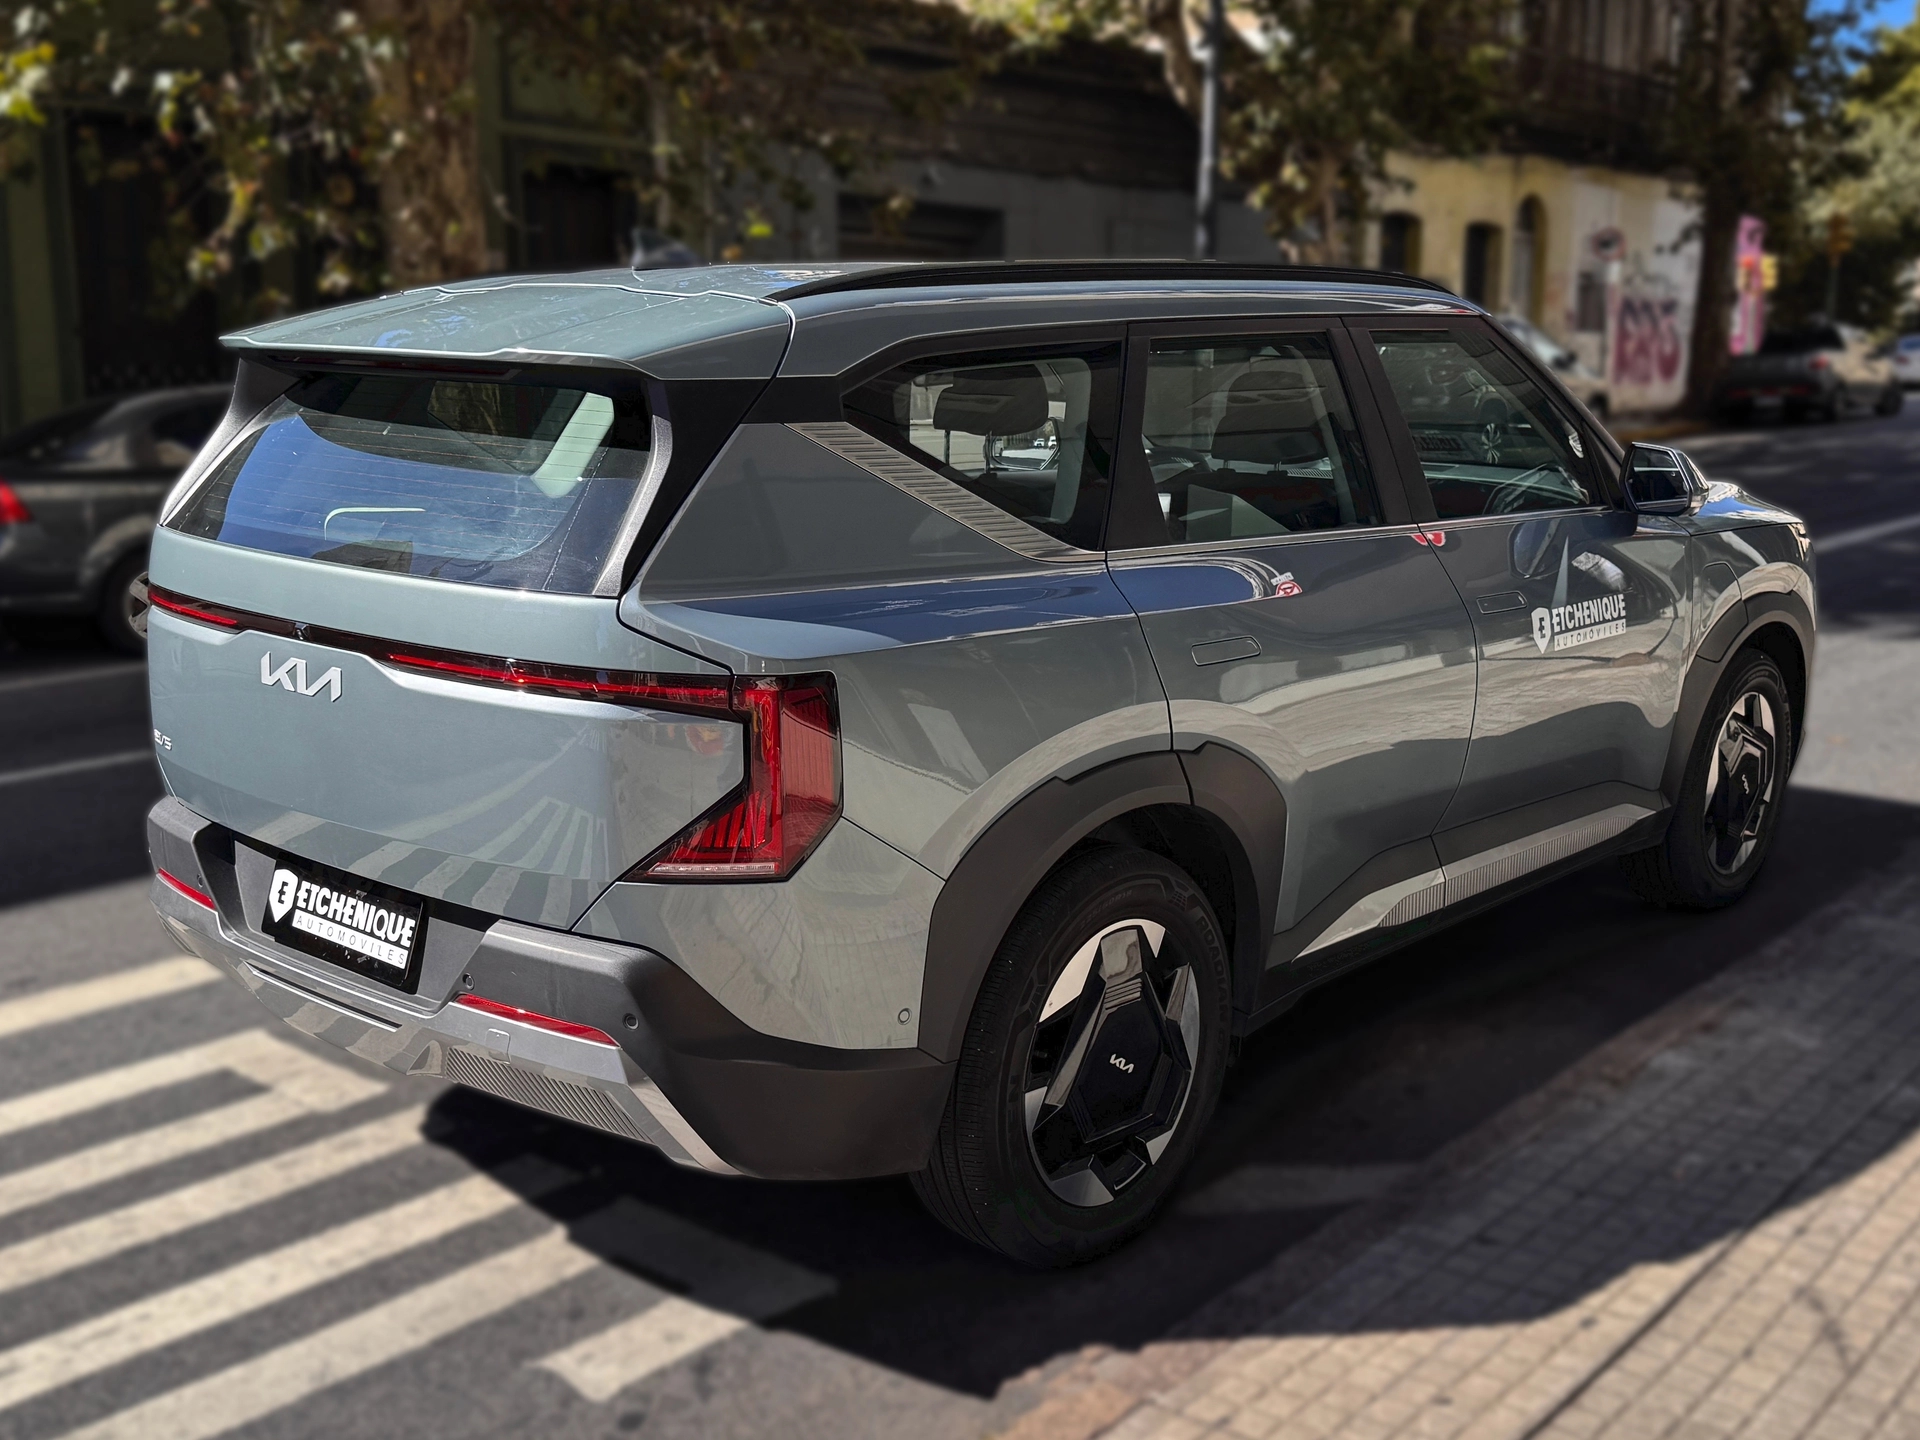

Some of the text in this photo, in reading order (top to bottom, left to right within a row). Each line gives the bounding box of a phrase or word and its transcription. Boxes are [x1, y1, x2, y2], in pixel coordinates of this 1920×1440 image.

[1552, 594, 1626, 633] ETCHENIQUE
[1556, 625, 1625, 647] AUTOMOVILES
[261, 651, 342, 702] KIA
[297, 880, 416, 948] ETCHENIQUE
[297, 915, 404, 965] AUTOMOVILES
[1110, 1053, 1134, 1073] KIA
